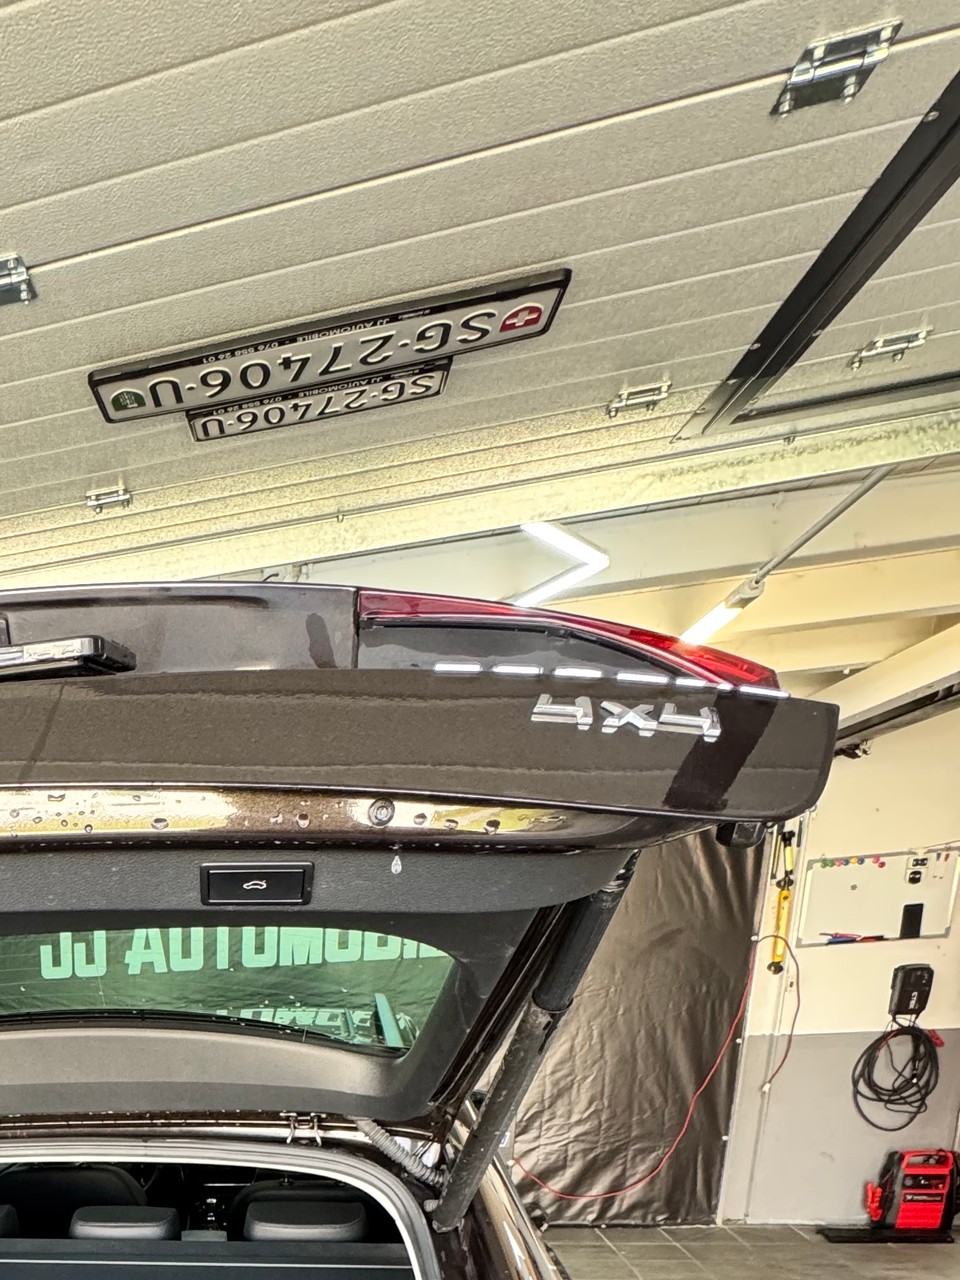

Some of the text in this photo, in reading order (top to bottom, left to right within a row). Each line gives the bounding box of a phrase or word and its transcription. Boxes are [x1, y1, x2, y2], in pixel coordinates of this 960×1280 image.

[296, 321, 375, 343] AUTOMOBILE
[257, 341, 279, 351] 076
[297, 378, 367, 398] AUTOMOBILE
[263, 396, 282, 405] 076
